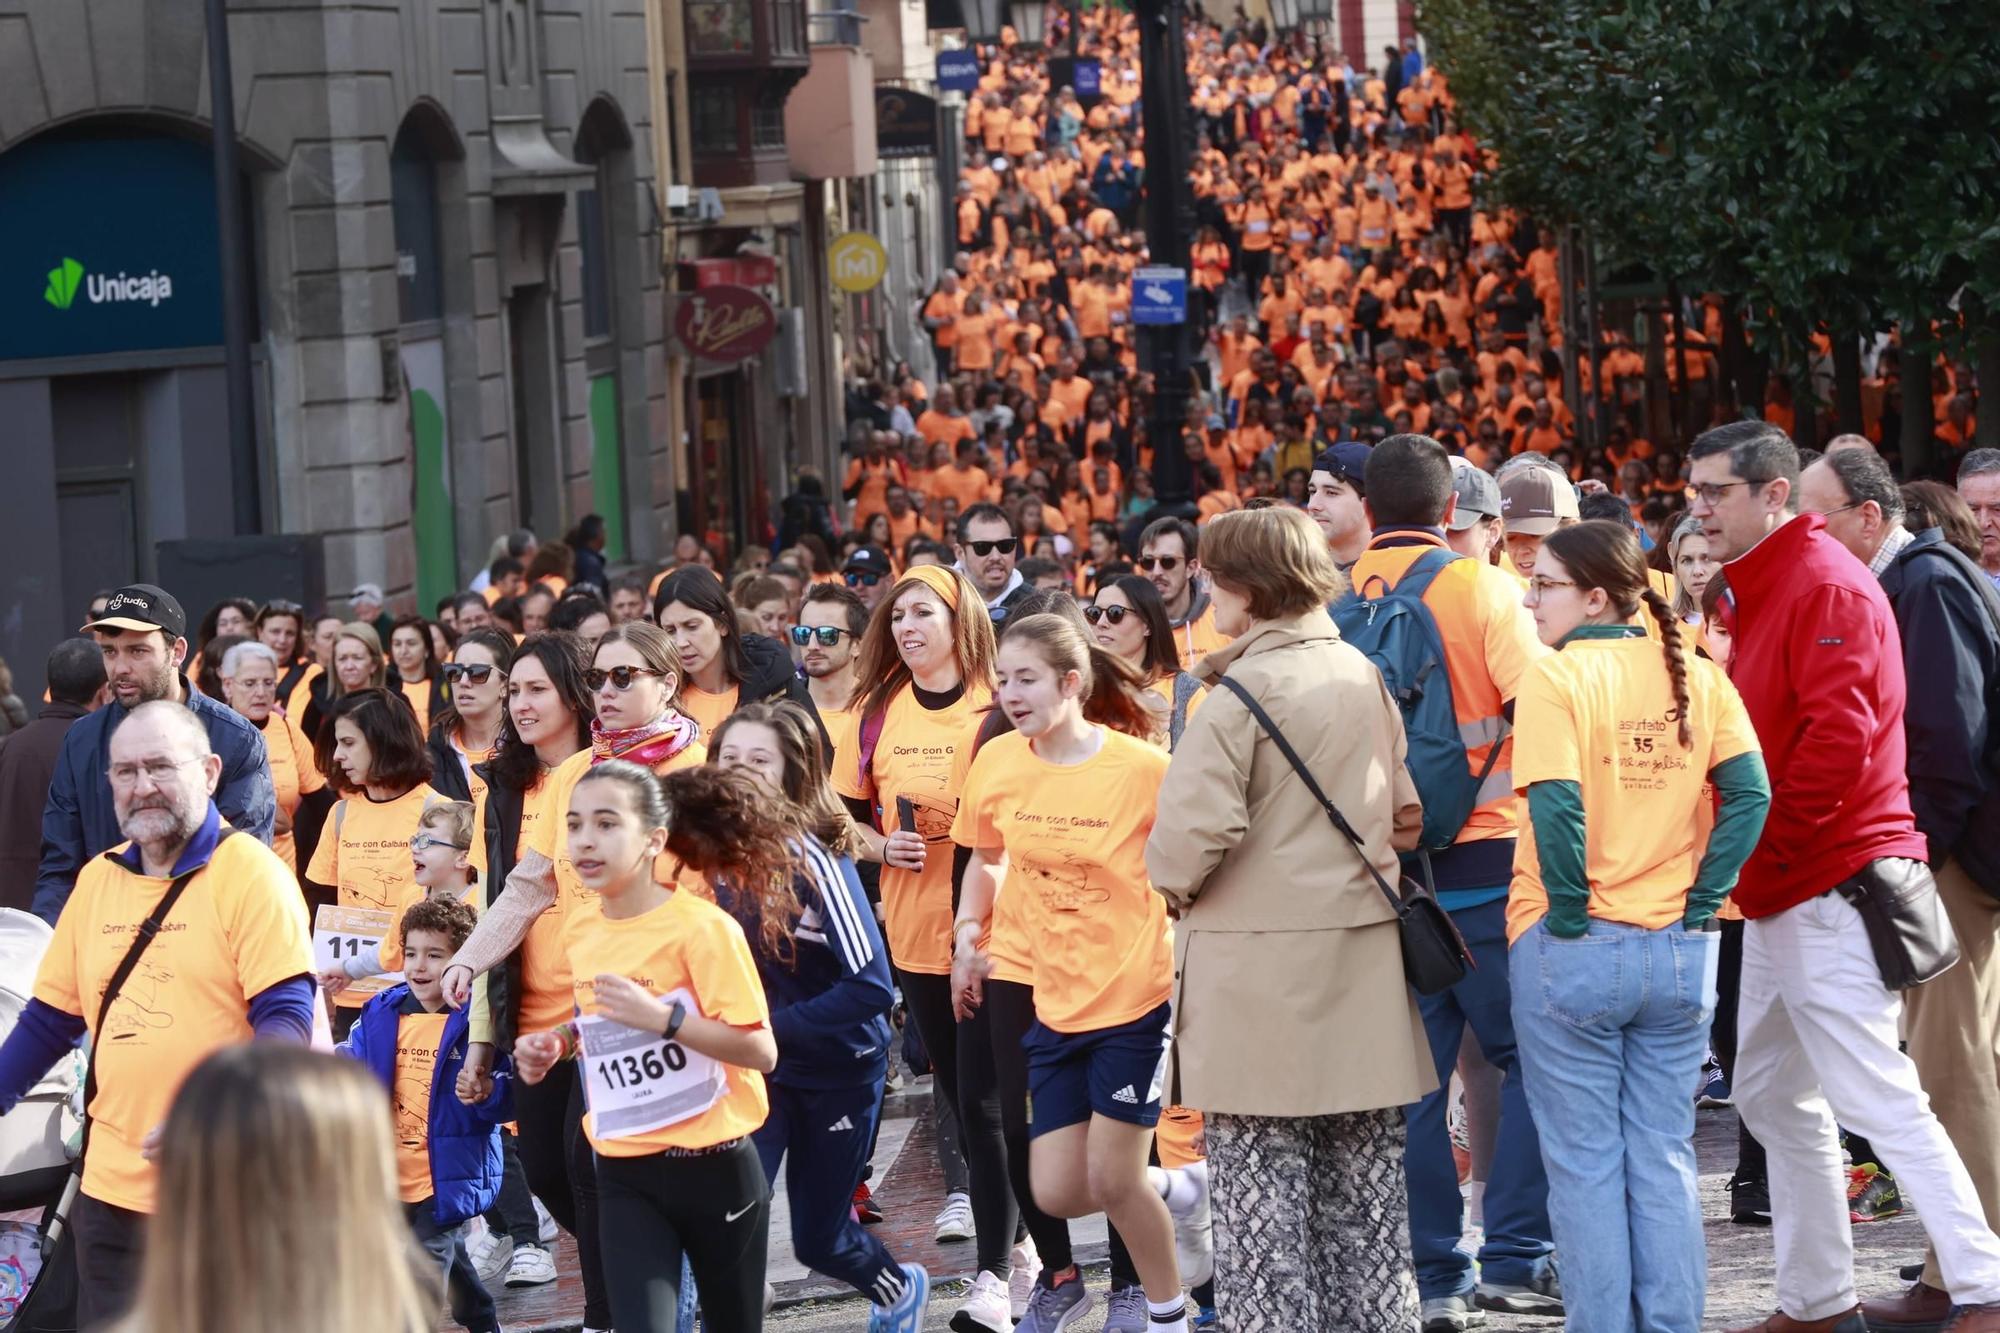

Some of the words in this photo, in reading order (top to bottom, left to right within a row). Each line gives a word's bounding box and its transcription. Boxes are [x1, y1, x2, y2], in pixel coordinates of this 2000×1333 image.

[940, 64, 978, 78] BBVA
[87, 269, 172, 307] Unicaja
[893, 745, 919, 755] Corre
[922, 747, 943, 755] con
[1632, 737, 1654, 754] 35
[1014, 811, 1042, 823] Corre
[1046, 815, 1067, 825] con
[1070, 816, 1110, 829] Galbán
[363, 840, 379, 848] con
[381, 840, 409, 848] Galbán
[411, 1047, 430, 1057] con
[598, 1042, 688, 1091] 11360
[1111, 1093, 1139, 1105] adidas
